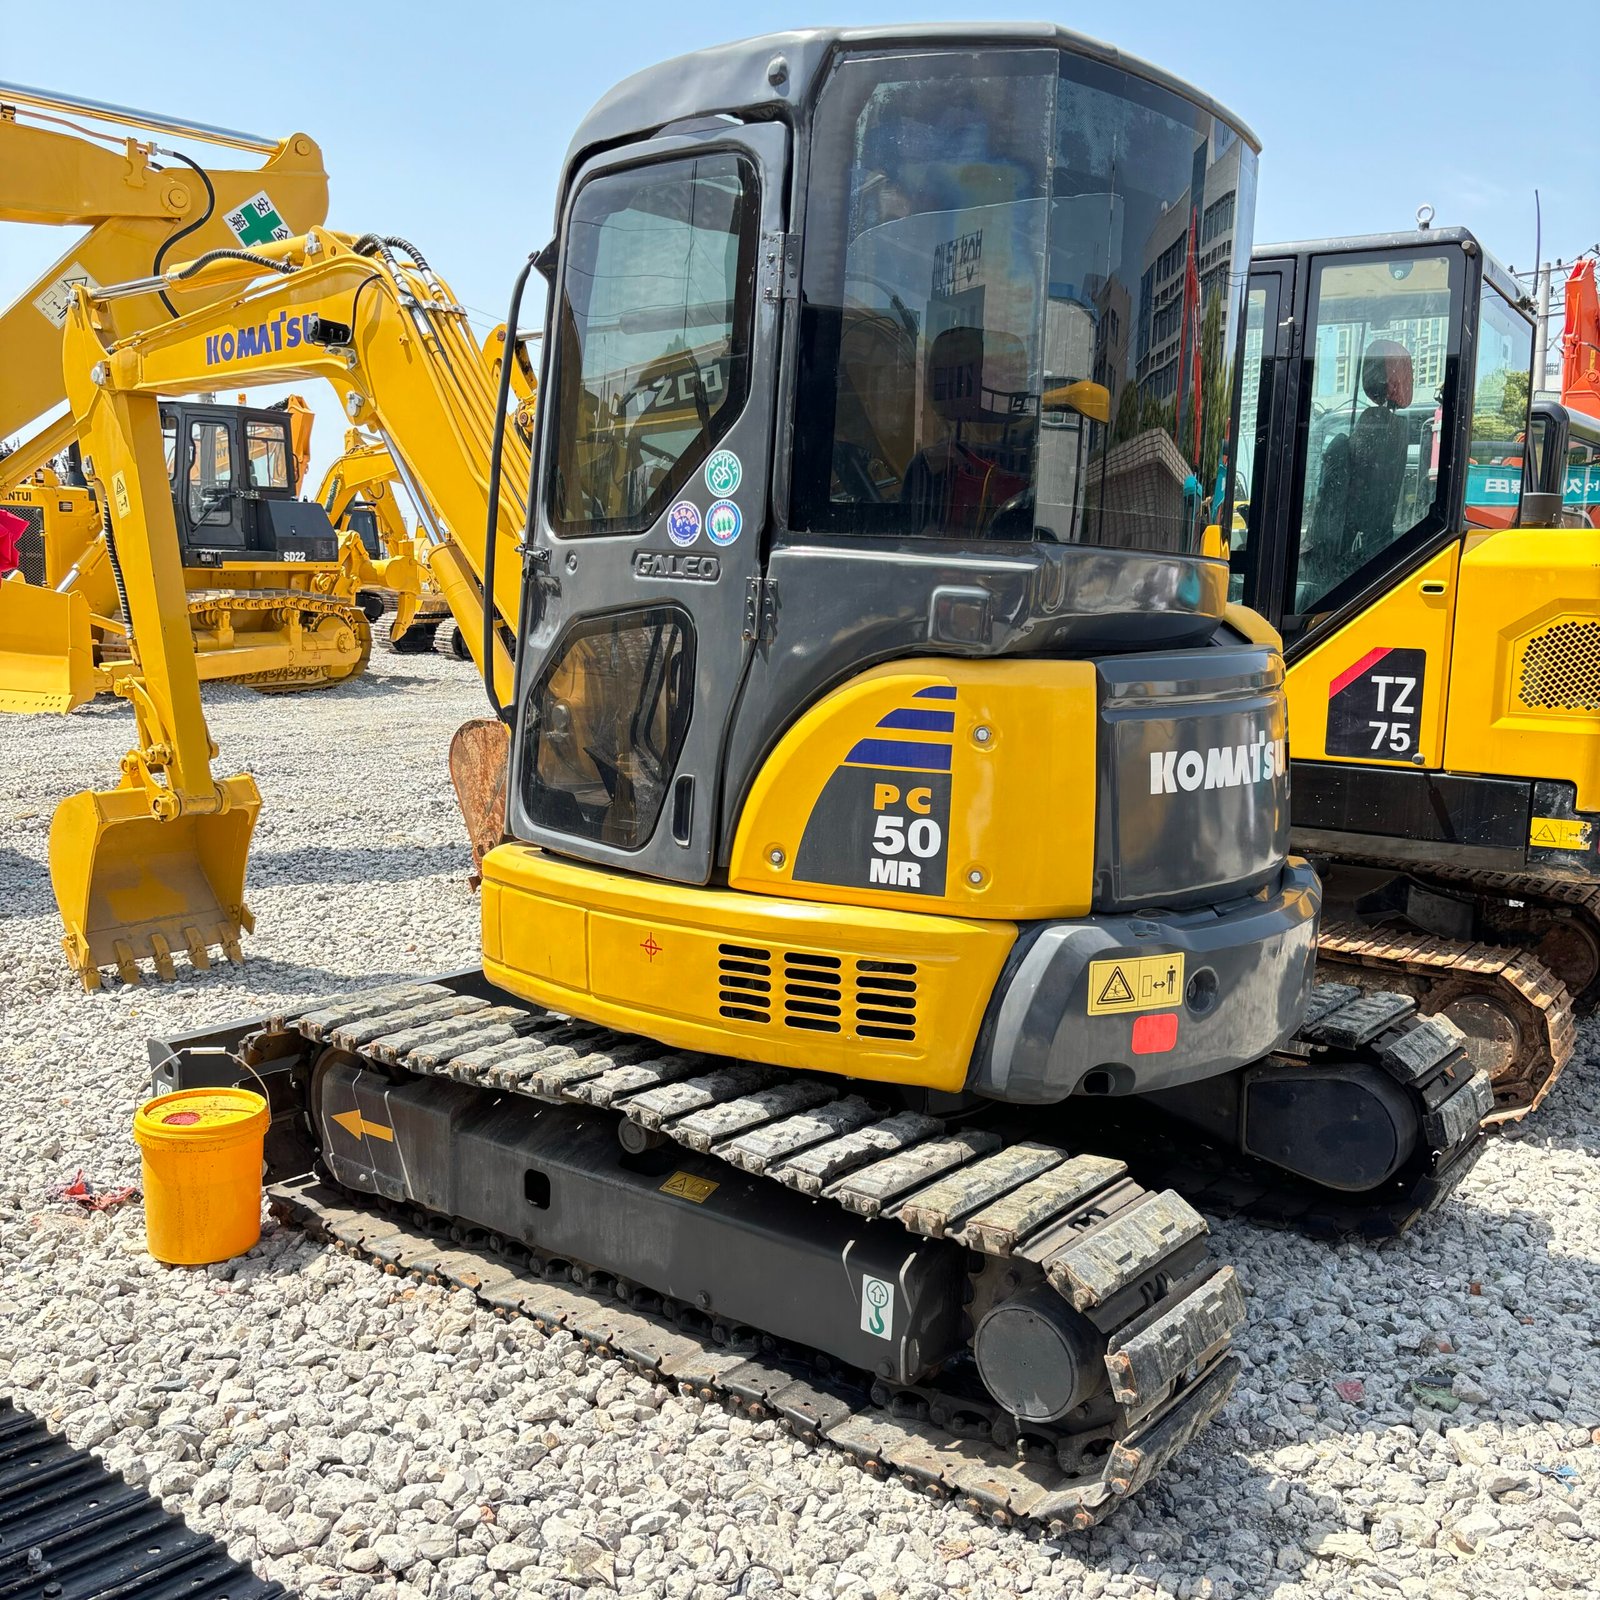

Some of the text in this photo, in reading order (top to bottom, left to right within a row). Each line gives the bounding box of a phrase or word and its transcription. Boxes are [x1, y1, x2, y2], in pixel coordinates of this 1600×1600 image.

[6, 491, 32, 502] NTUI
[283, 551, 306, 562] SD22
[634, 553, 720, 578] GALEO
[1371, 675, 1416, 714] TZ
[1368, 721, 1411, 752] 75
[1150, 730, 1285, 795] KOMATSU
[873, 782, 932, 815] PC
[872, 815, 942, 858] 50
[869, 858, 921, 888] MR
